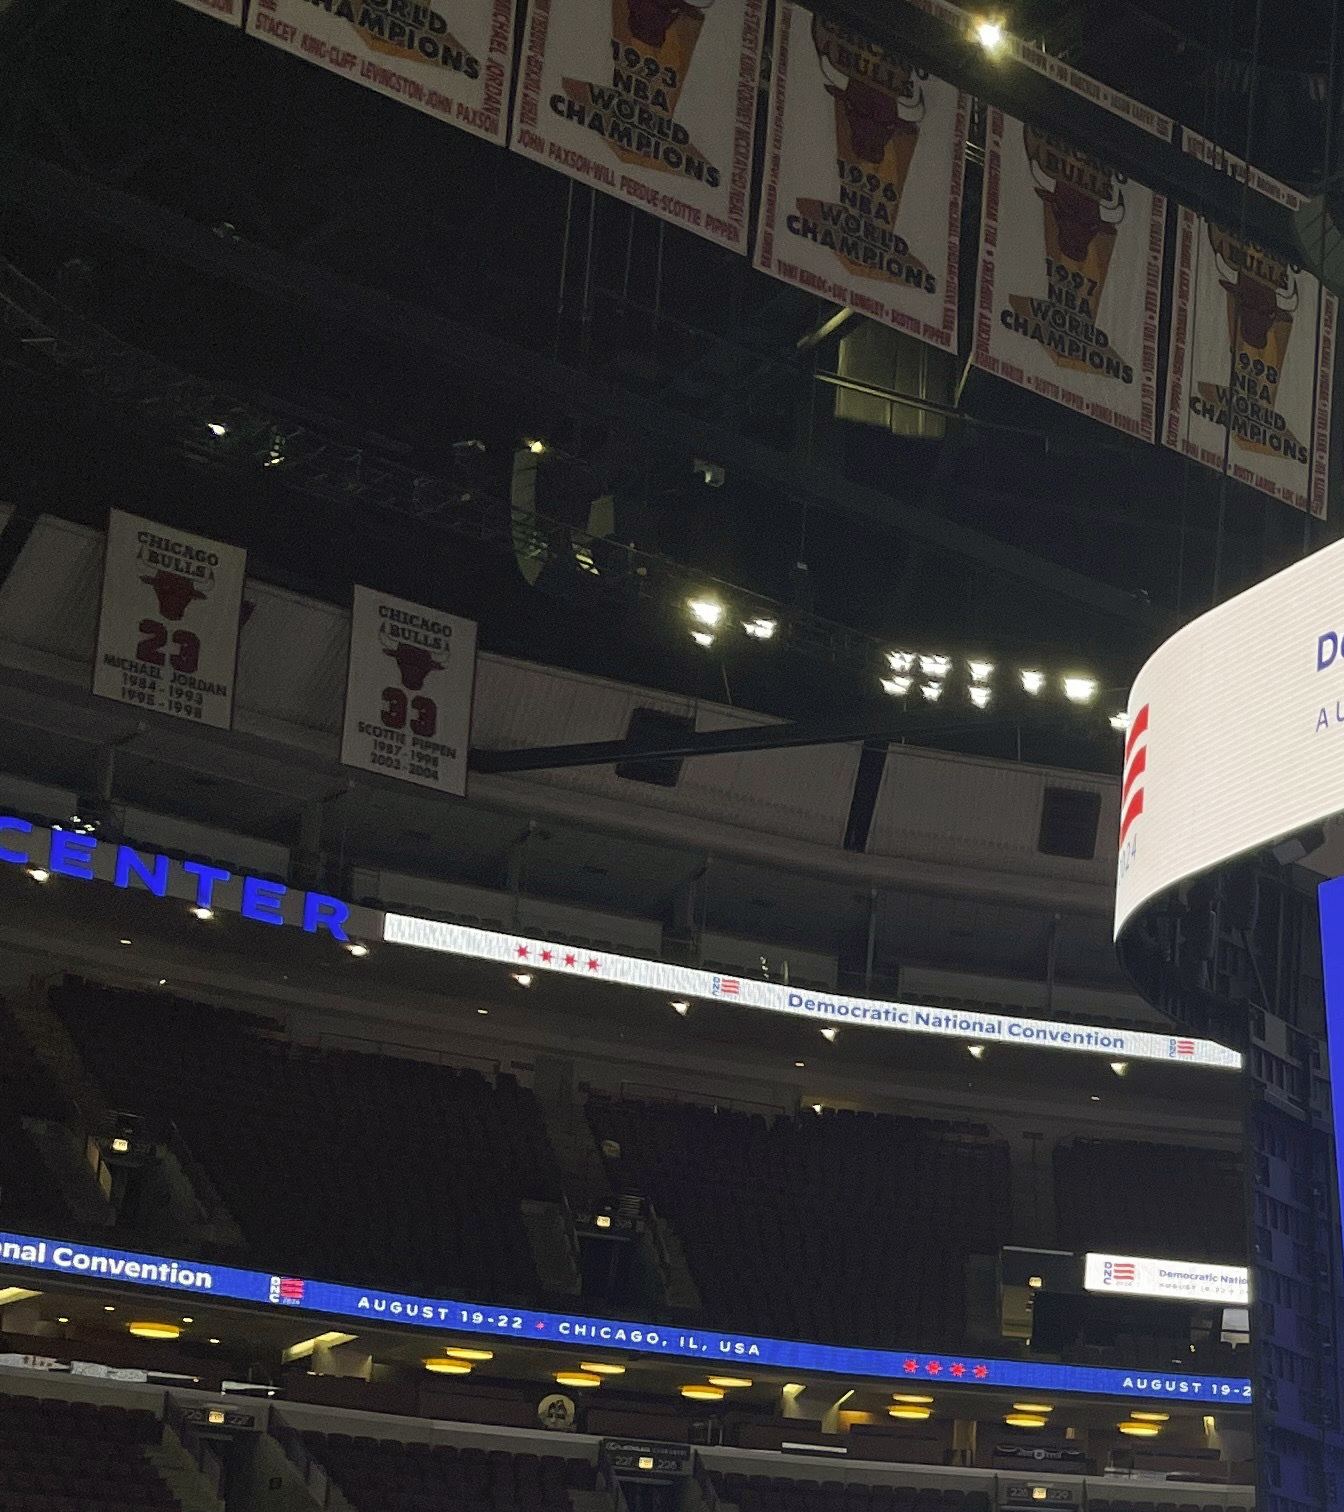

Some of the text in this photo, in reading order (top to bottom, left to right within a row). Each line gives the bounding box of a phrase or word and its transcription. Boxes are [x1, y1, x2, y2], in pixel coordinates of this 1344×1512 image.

[611, 38, 678, 89] 1993
[612, 66, 670, 113] NBA
[590, 82, 690, 146] WORLD
[549, 93, 721, 188] CHAMPIONS
[836, 157, 898, 202] 1996
[839, 183, 892, 225] NBA
[820, 200, 910, 257] WORLD
[785, 213, 937, 295] CHAMPIONS
[1045, 256, 1099, 298] 1997
[1028, 296, 1110, 349] WORLD
[1047, 281, 1093, 318] NBA
[1000, 308, 1134, 385] CHAMPIONS
[1216, 383, 1286, 432] WORLD
[1231, 371, 1273, 405] NBA
[1189, 395, 1308, 465] CHAMPIONS
[136, 530, 220, 568] CHICAGO
[146, 549, 207, 580] BULLS
[377, 604, 454, 638] CHICAGO
[389, 622, 443, 650] BULLS
[136, 618, 201, 673] 23
[104, 653, 228, 698] MICHAEL JORDAN
[380, 686, 438, 738] 33
[357, 720, 458, 761] SCOTTIE PIPPEN
[0, 815, 350, 942] CENTER
[787, 992, 1125, 1051] Democratic National Convention
[53, 1245, 213, 1290] Convention
[1158, 1269, 1219, 1284] Democratic
[357, 1296, 450, 1322] AUGUST
[460, 1310, 525, 1330] 19-22
[558, 1321, 669, 1348] CHICAGO,
[719, 1340, 761, 1357] USA
[1122, 1376, 1202, 1395] AUGUST
